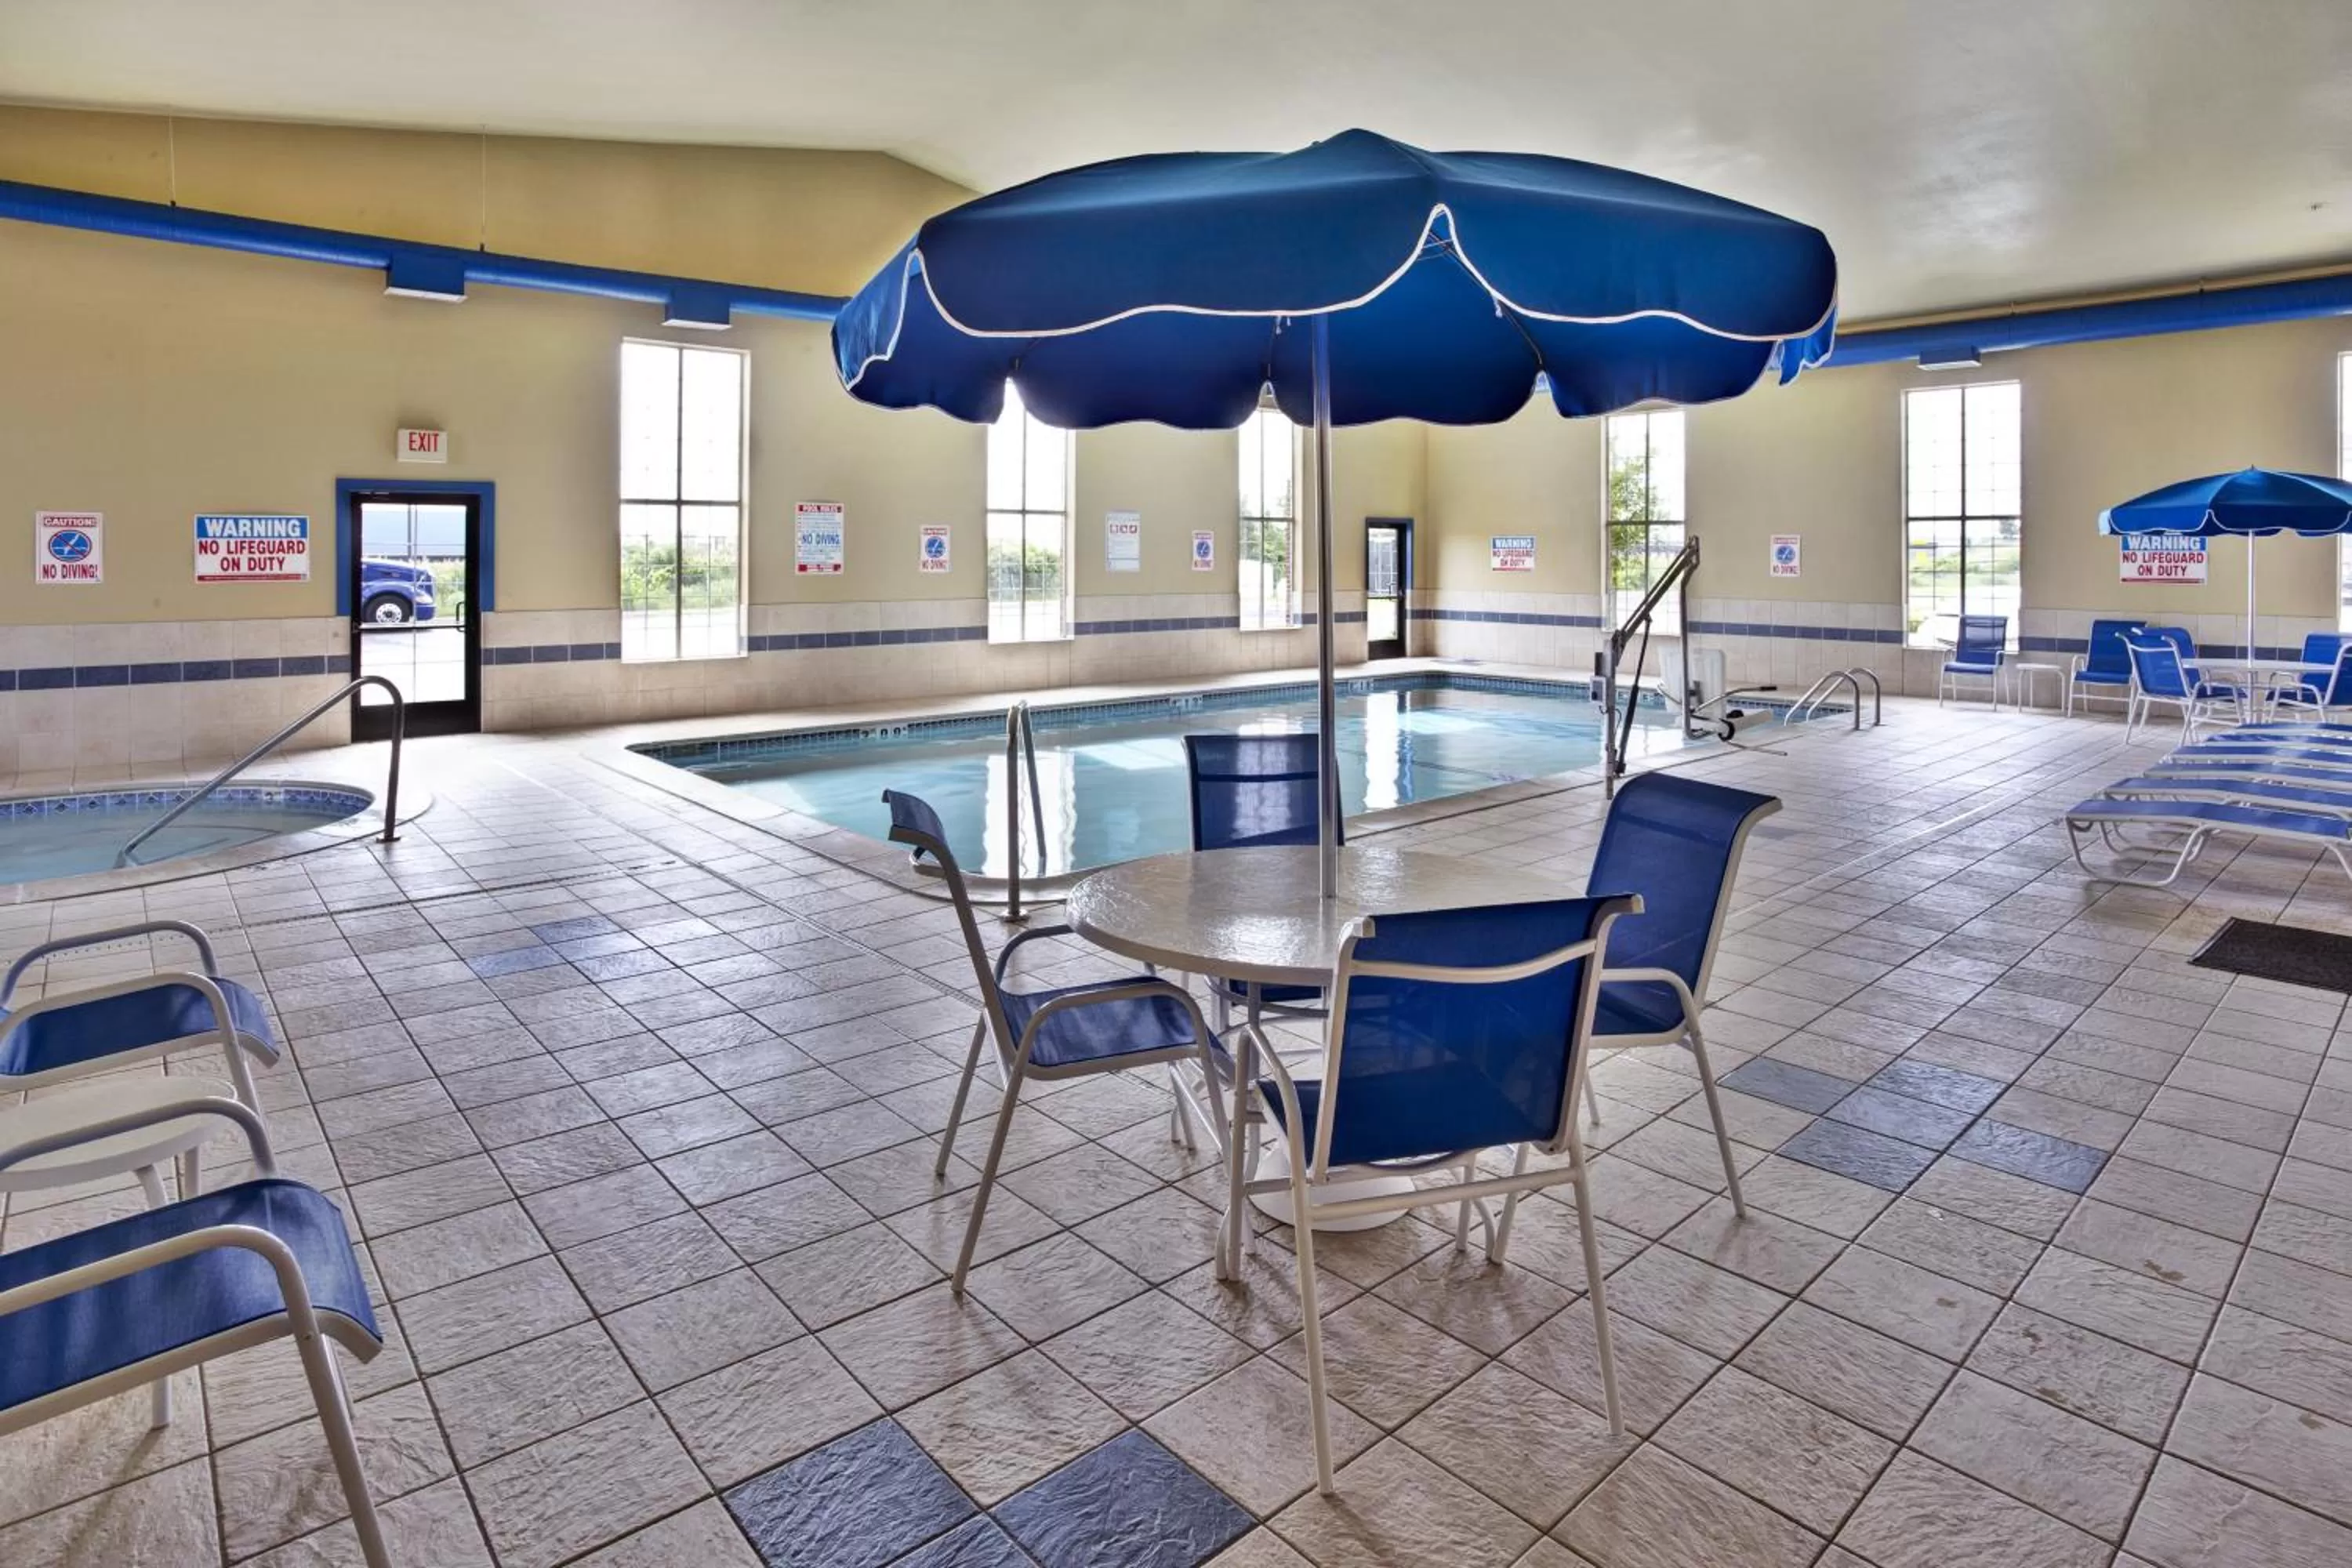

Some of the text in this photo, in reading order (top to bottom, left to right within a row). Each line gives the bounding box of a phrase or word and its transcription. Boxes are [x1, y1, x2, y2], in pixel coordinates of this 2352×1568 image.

[408, 432, 439, 452] EXIT
[204, 518, 301, 537] WARNING
[802, 533, 813, 544] NO
[2128, 535, 2201, 550] WARNING
[198, 540, 306, 555] NO LIFEGUARD
[220, 557, 285, 572] ON DUTY
[2122, 552, 2204, 564] NO LIFEGUARD
[42, 564, 98, 579] NO DIVING!
[2138, 564, 2188, 576] ON DUTY
